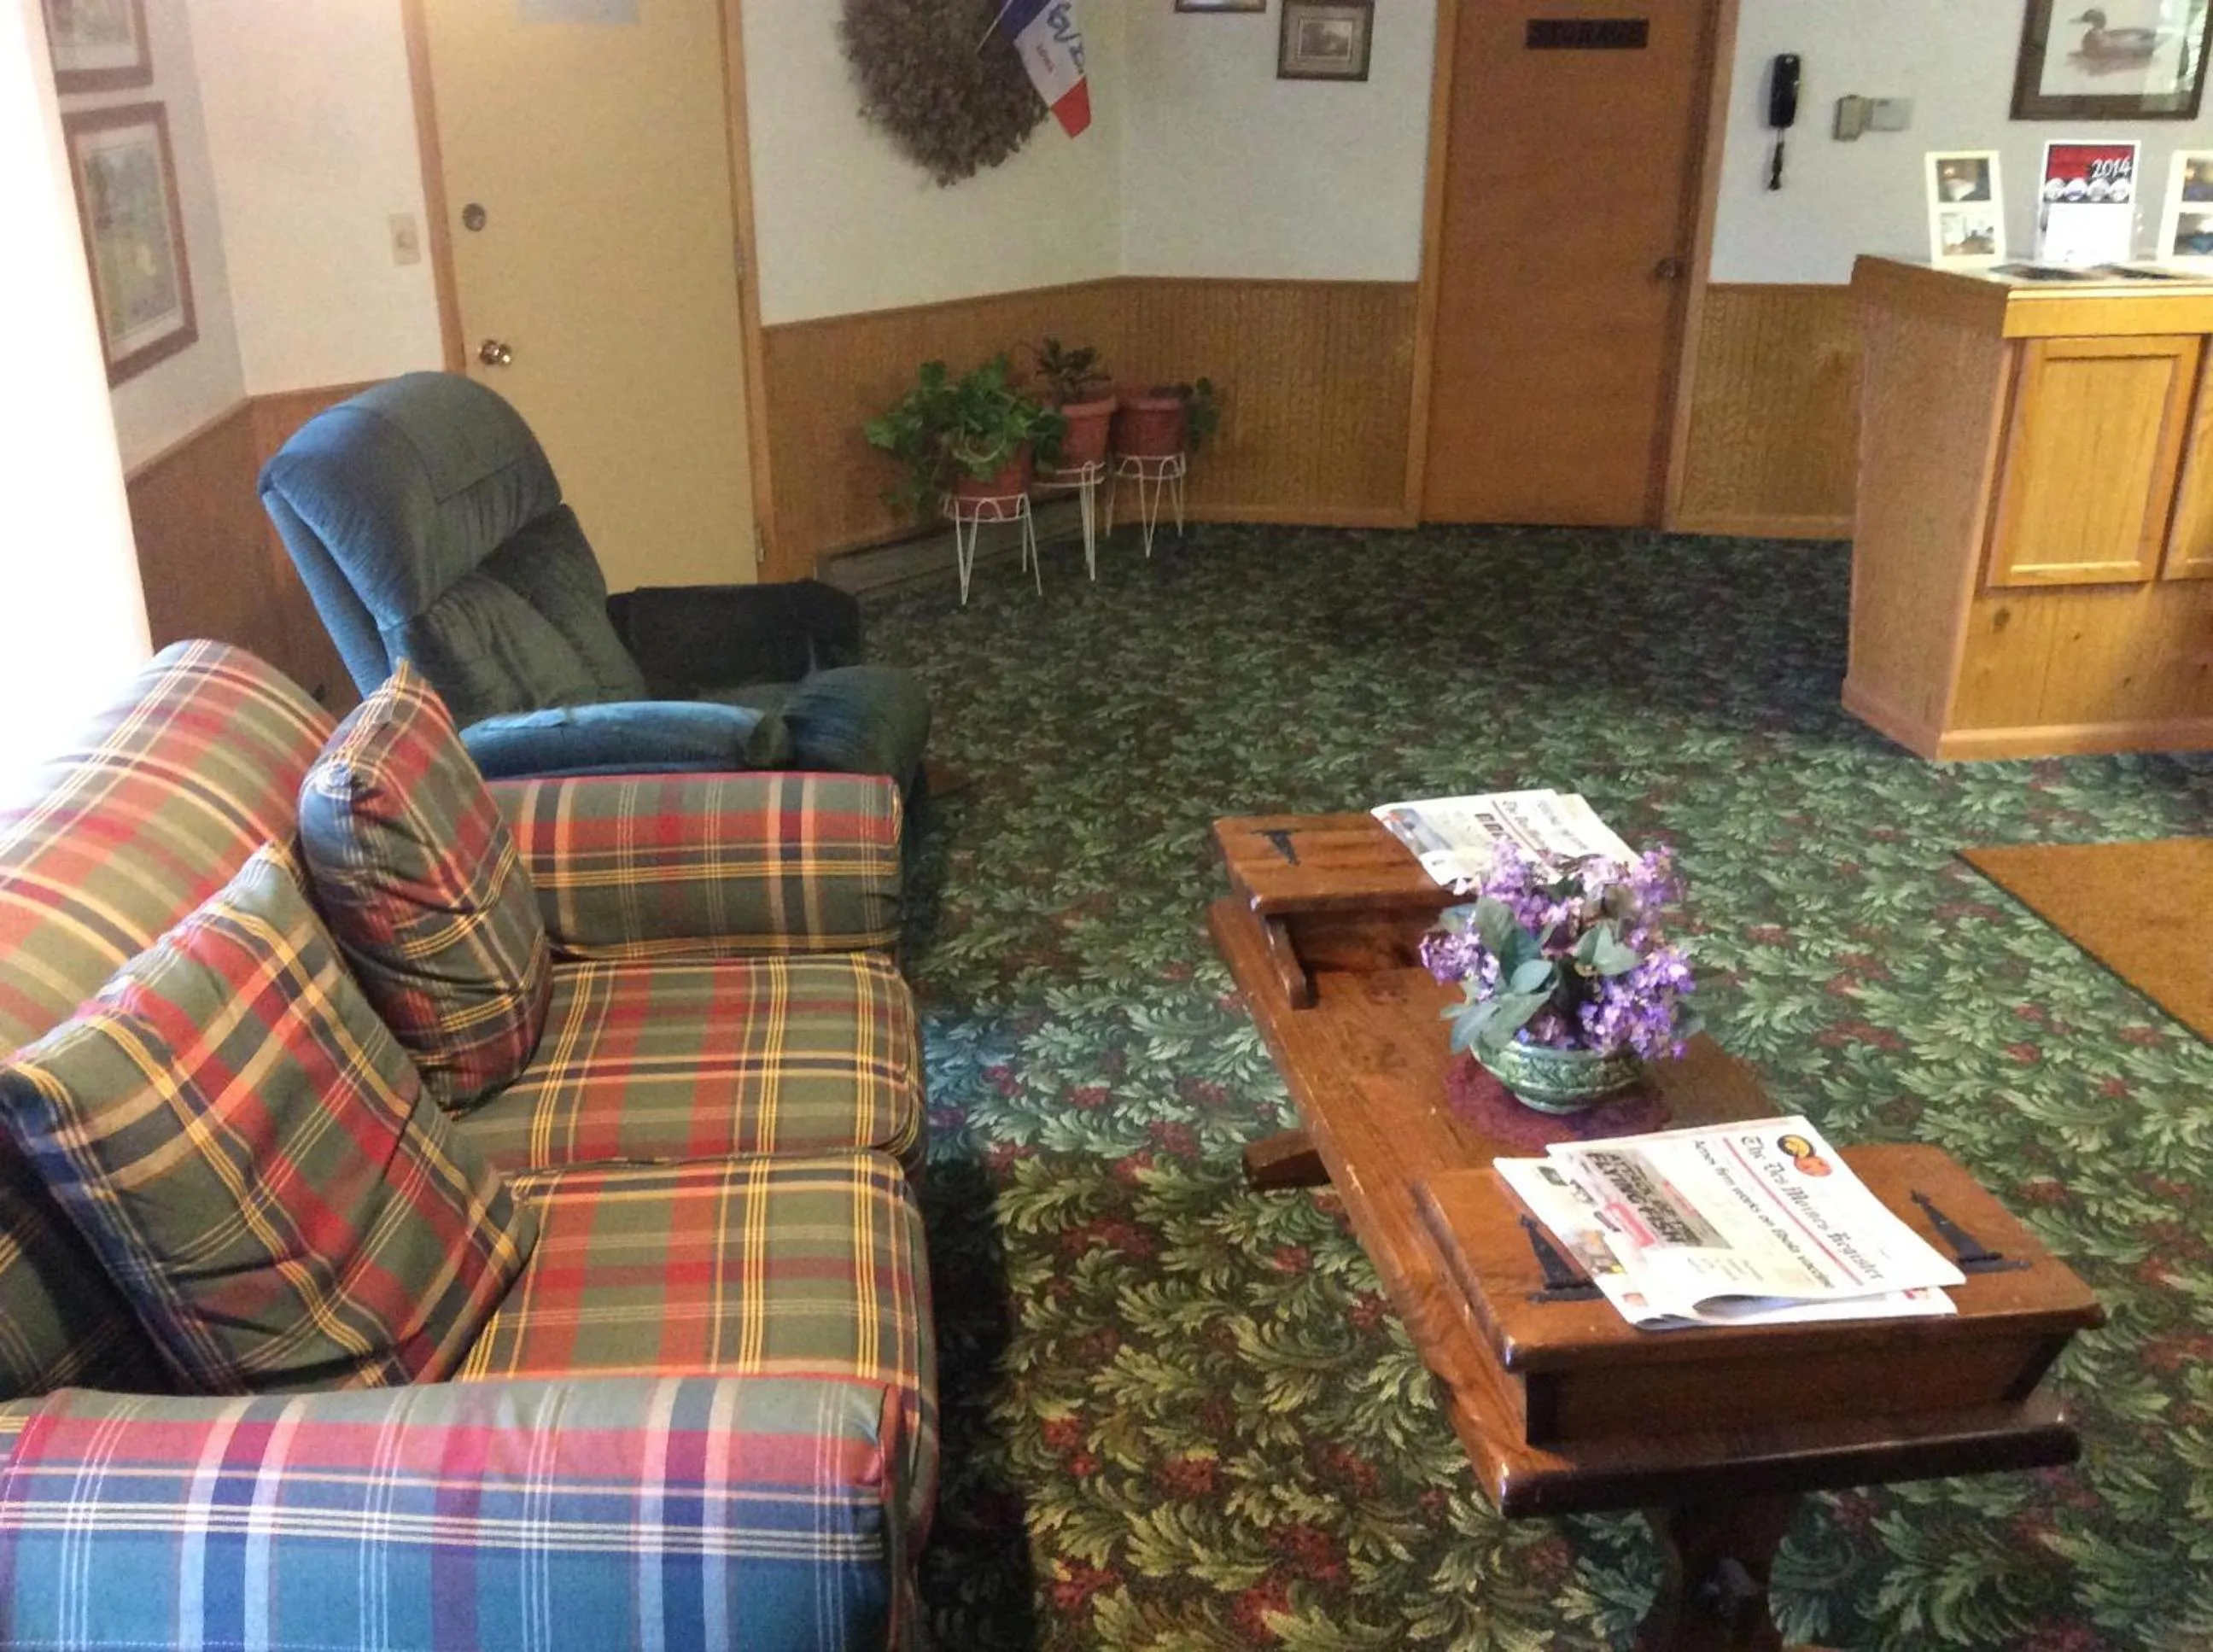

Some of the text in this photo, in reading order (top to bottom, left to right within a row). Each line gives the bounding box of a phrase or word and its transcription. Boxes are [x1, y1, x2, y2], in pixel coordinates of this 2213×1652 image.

[2092, 155, 2132, 178] 2014
[1741, 1135, 1883, 1279] The Des Moines Register
